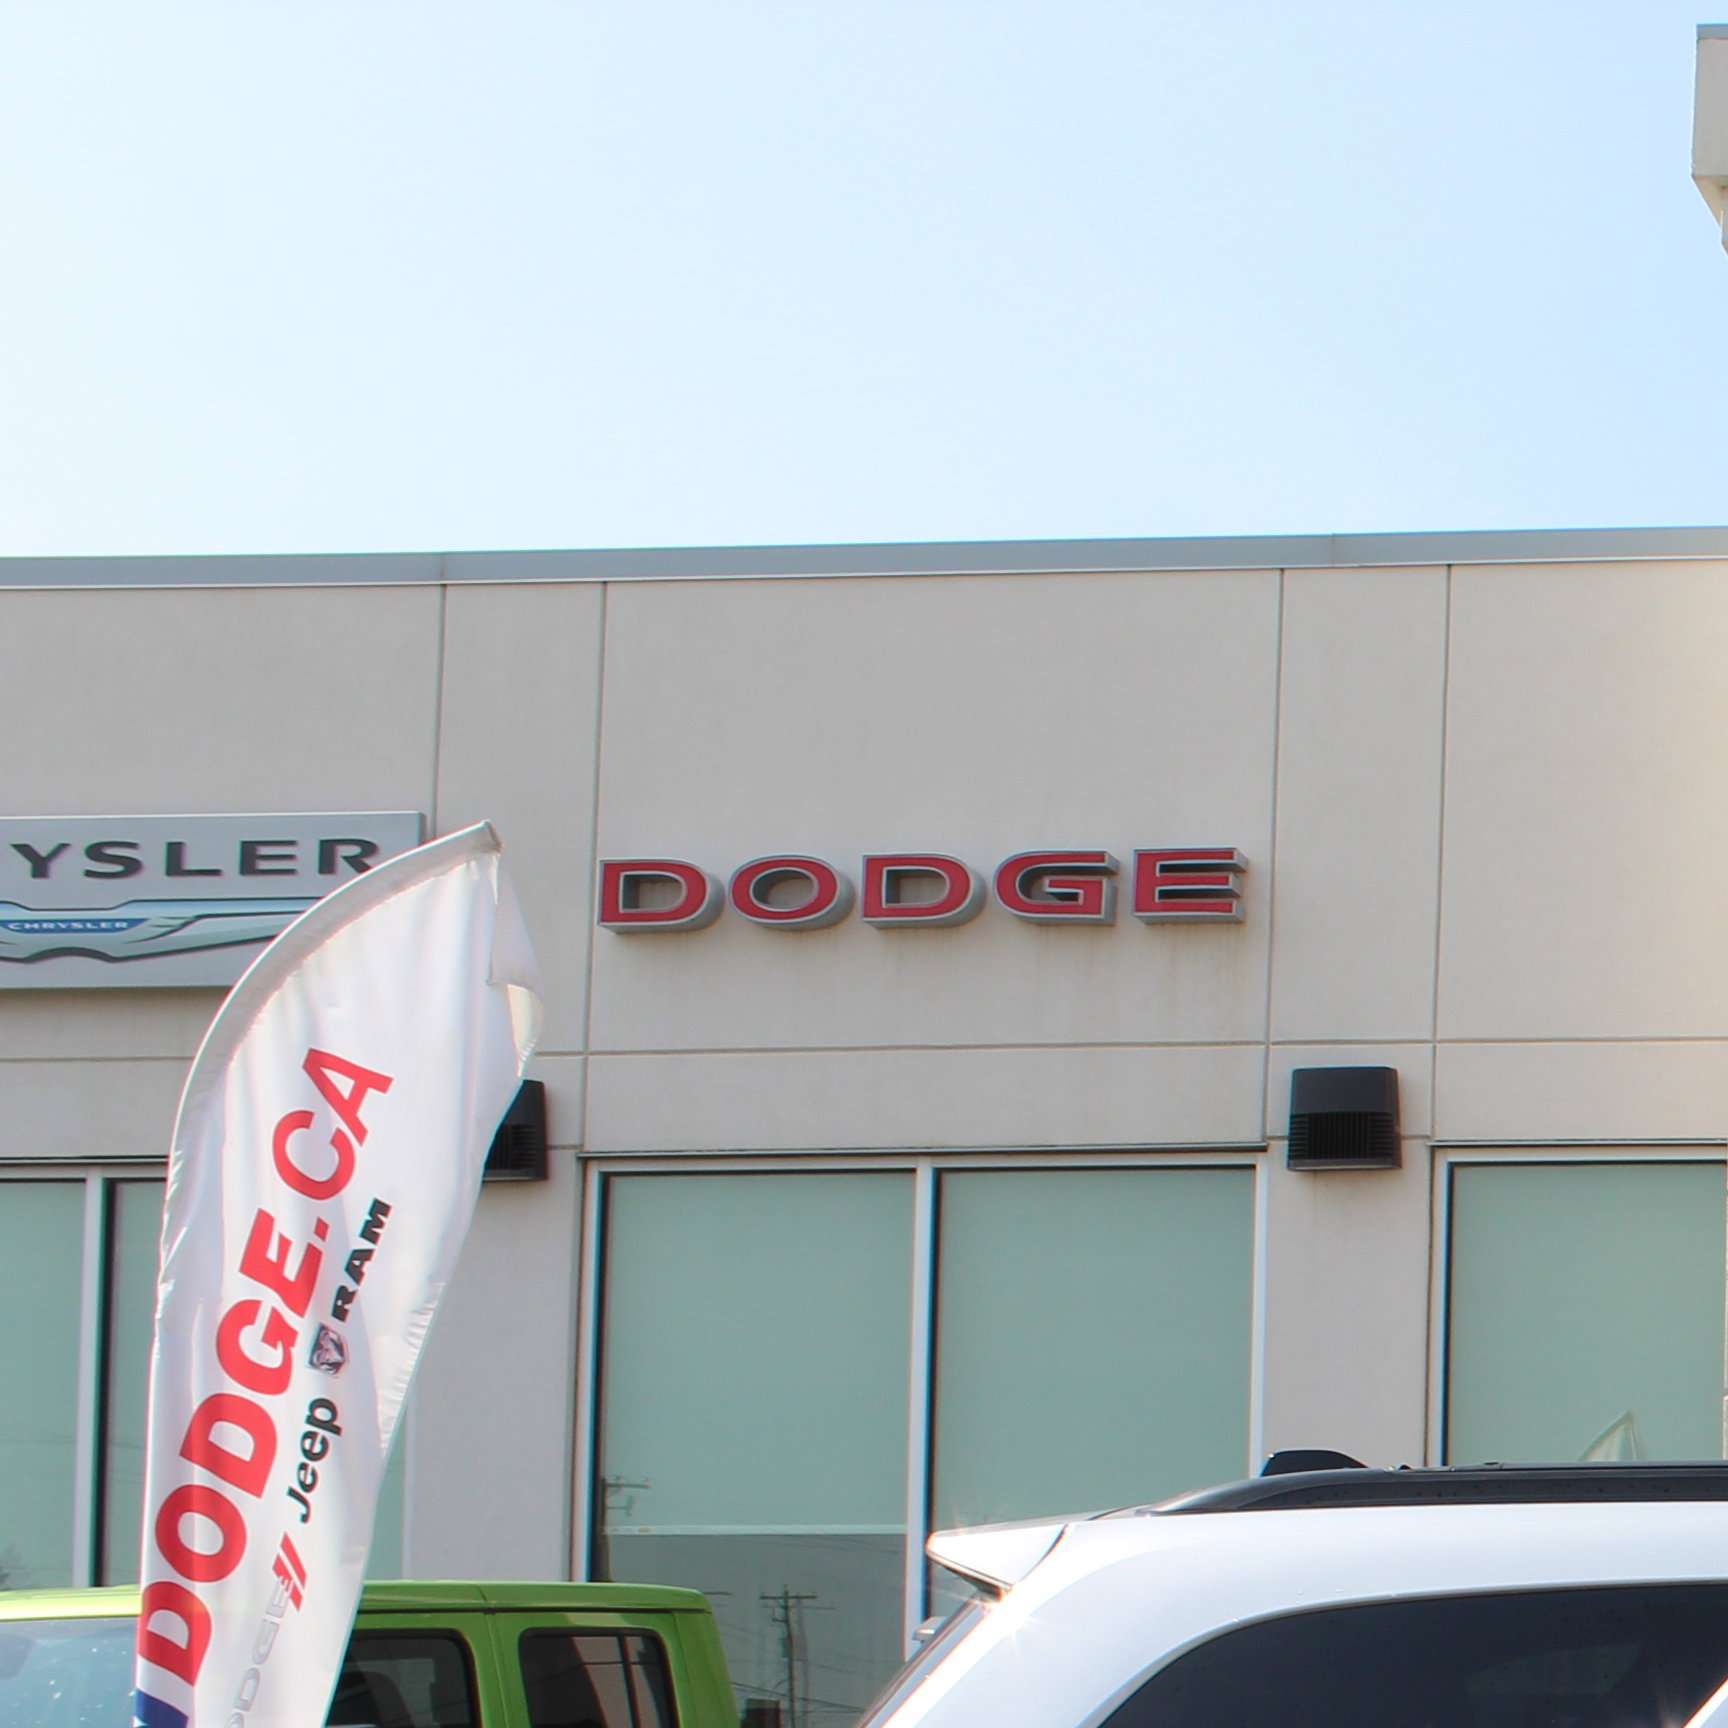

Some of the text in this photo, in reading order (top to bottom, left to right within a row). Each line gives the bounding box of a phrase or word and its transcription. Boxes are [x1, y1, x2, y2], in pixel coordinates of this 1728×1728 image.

[10, 838, 380, 880] YSLER
[597, 846, 1248, 936] DODGE
[7, 921, 129, 930] CHRYSLER
[286, 1396, 344, 1524] Jeep
[331, 1197, 393, 1323] RAM
